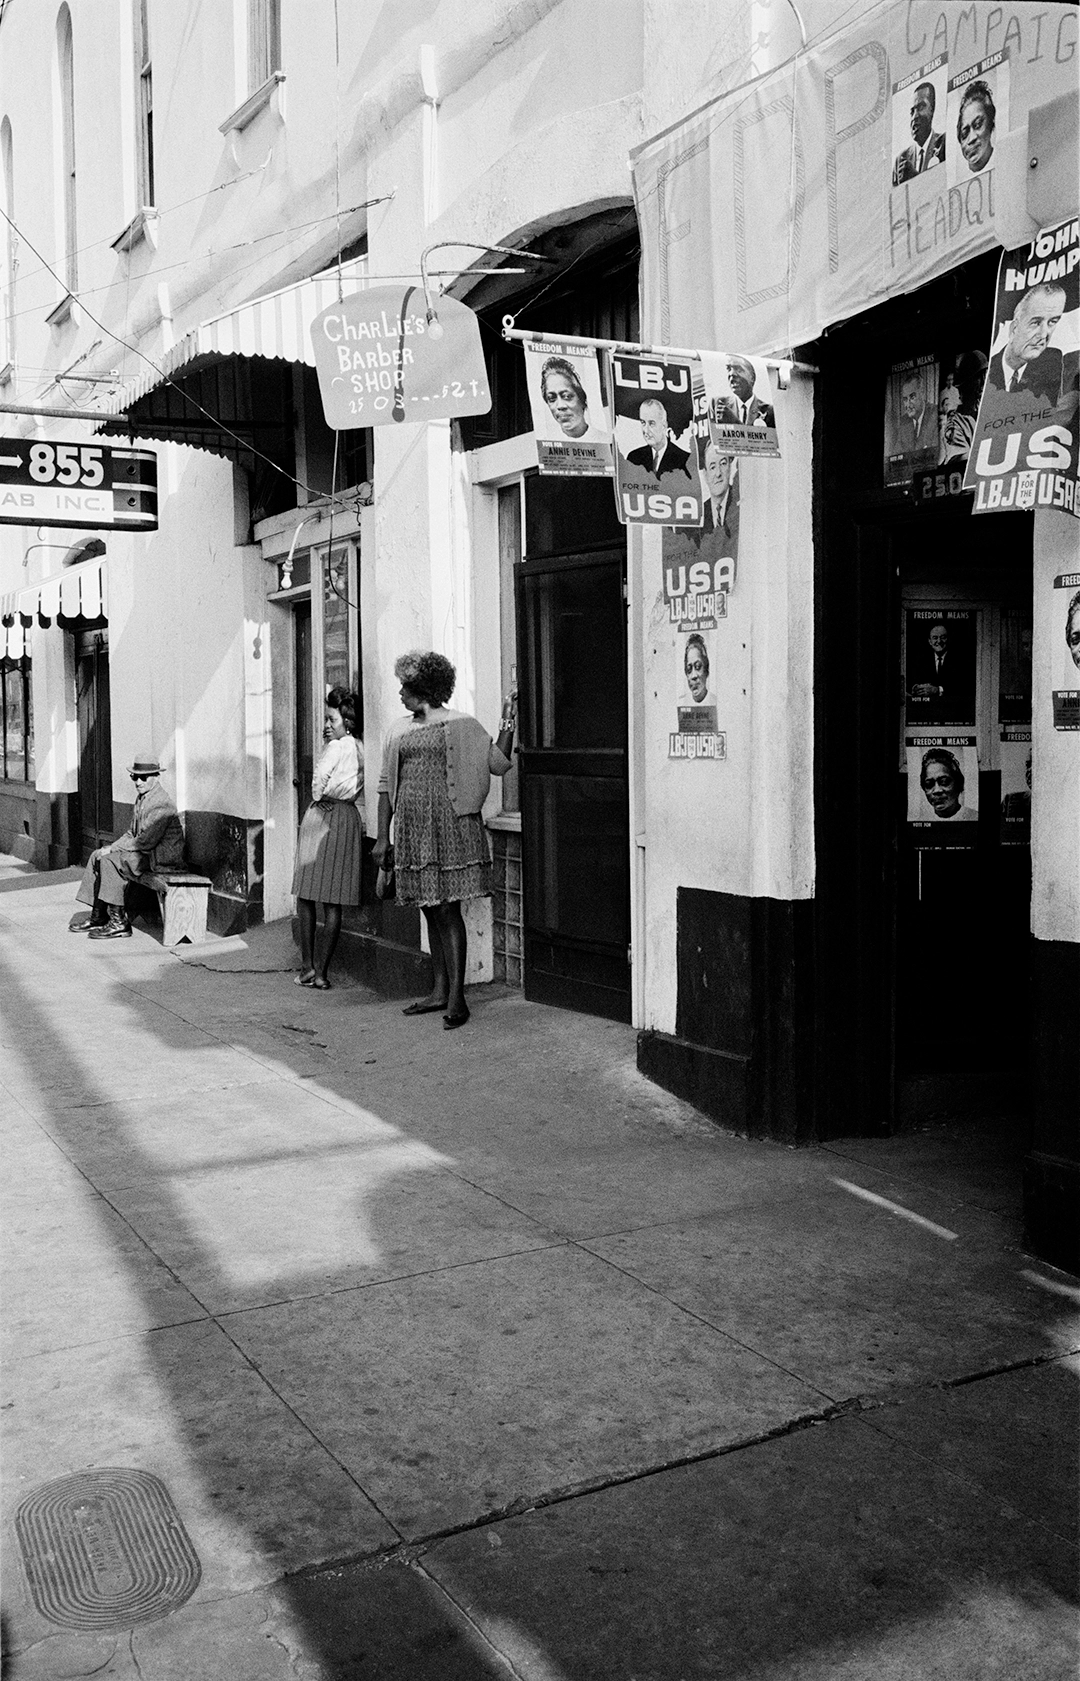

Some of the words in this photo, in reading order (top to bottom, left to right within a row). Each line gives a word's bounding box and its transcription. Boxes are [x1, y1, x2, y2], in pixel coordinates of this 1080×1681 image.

[897, 68, 921, 91] FREEDOM
[922, 56, 942, 77] MEANS
[952, 66, 980, 89] FREEDOM
[981, 52, 1003, 73] MEANS
[531, 343, 563, 354] FREEDOM
[566, 346, 593, 357] MEANS
[351, 370, 405, 394] SHOP
[614, 361, 688, 393] LBJ
[983, 416, 1015, 432] FOR
[1022, 407, 1054, 423] THE
[722, 430, 745, 439] AARON
[747, 431, 767, 440] HENRY
[548, 447, 570, 456] ANNIE
[572, 448, 597, 458] DEVINE
[975, 425, 1080, 476] US
[29, 443, 104, 487] 855
[642, 483, 660, 491] THE
[976, 477, 1018, 510] LBJ
[1020, 490, 1032, 498] THE
[1021, 480, 1034, 488] FOR
[1038, 473, 1074, 511] USA
[56, 495, 105, 512] INC.
[622, 494, 699, 519] USA
[666, 557, 735, 597] USA
[914, 611, 943, 619] FREEDOM
[947, 611, 969, 619] MEANS
[670, 735, 687, 757] LBJ
[696, 735, 714, 757] USA
[913, 738, 943, 746] FREEDOM
[1007, 733, 1031, 741] FREEDO
